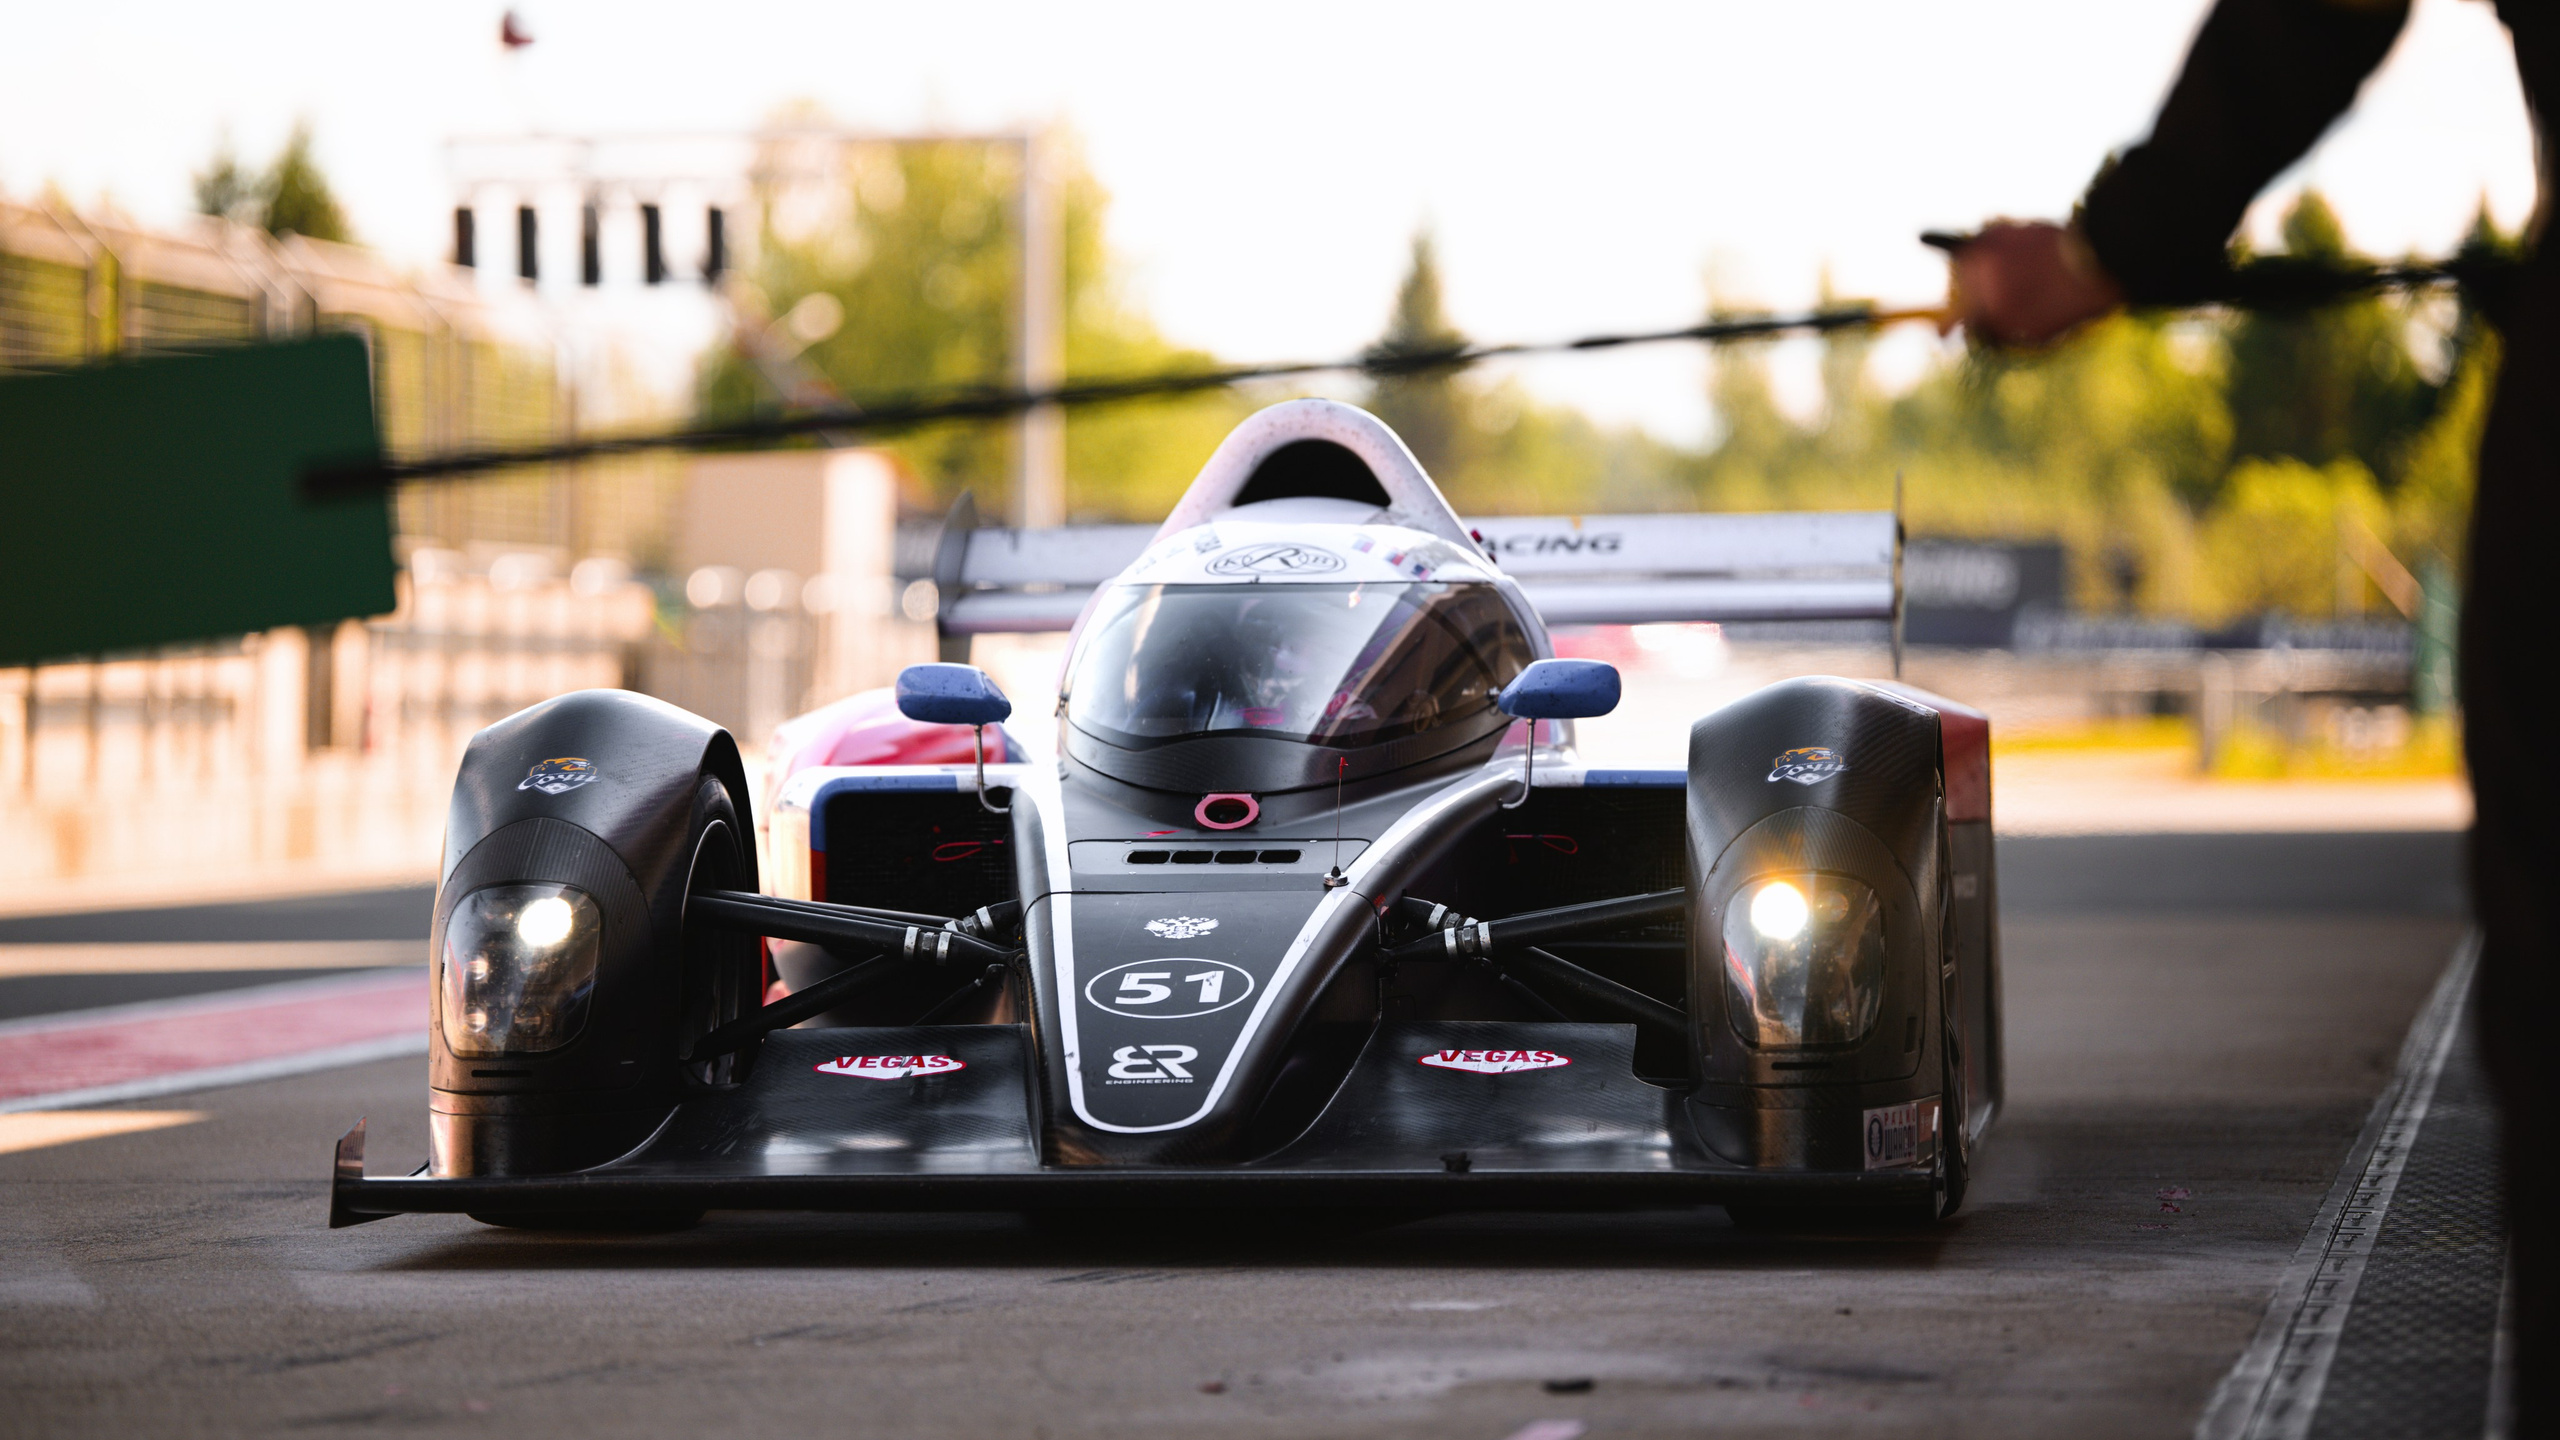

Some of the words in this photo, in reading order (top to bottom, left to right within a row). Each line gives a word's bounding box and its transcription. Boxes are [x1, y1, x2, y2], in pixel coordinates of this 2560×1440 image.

[1481, 533, 1622, 555] ACING
[1115, 970, 1225, 1005] 51
[835, 1055, 951, 1069] VEGAS
[1438, 1049, 1556, 1063] VEGAS
[1105, 1078, 1194, 1086] ENGINEERING
